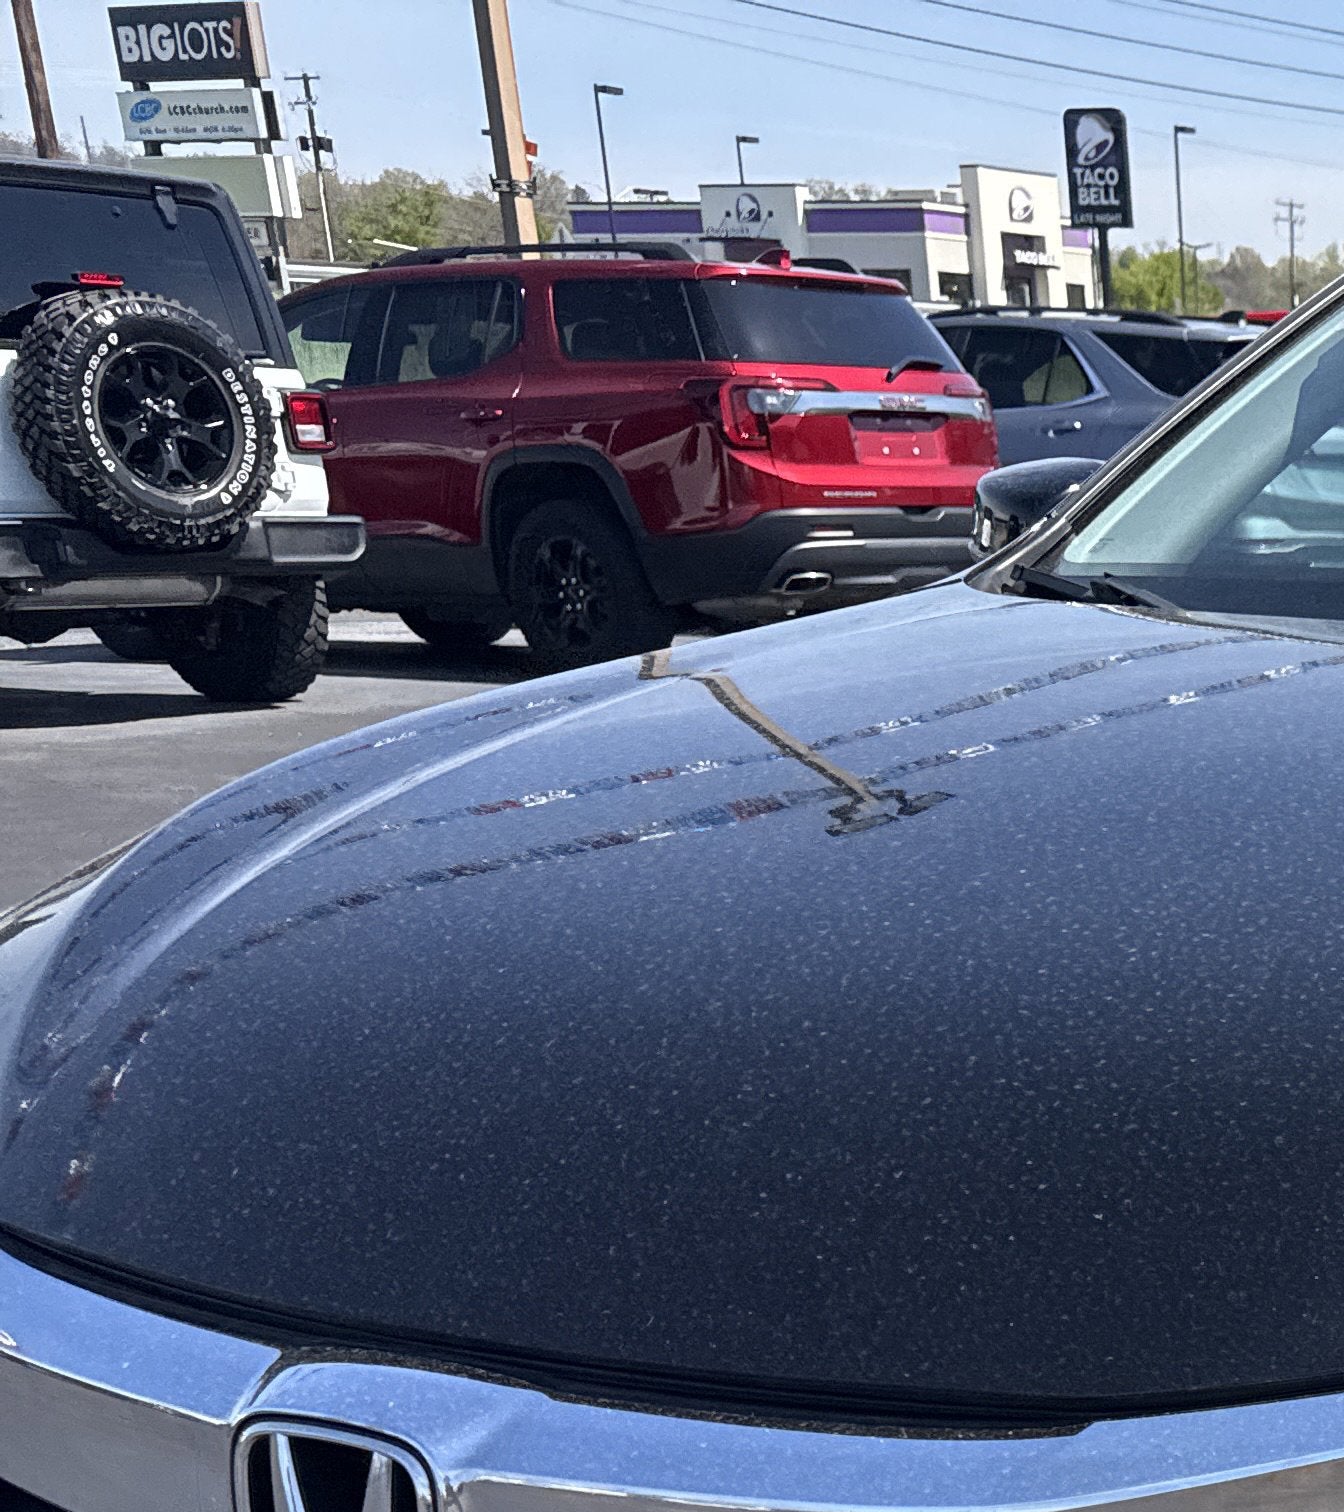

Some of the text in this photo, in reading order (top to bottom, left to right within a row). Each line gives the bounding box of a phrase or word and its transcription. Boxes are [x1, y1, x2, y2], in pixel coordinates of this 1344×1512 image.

[1072, 166, 1119, 187] TACO
[1078, 186, 1120, 206] BELL
[221, 367, 258, 496] DESTINATION
